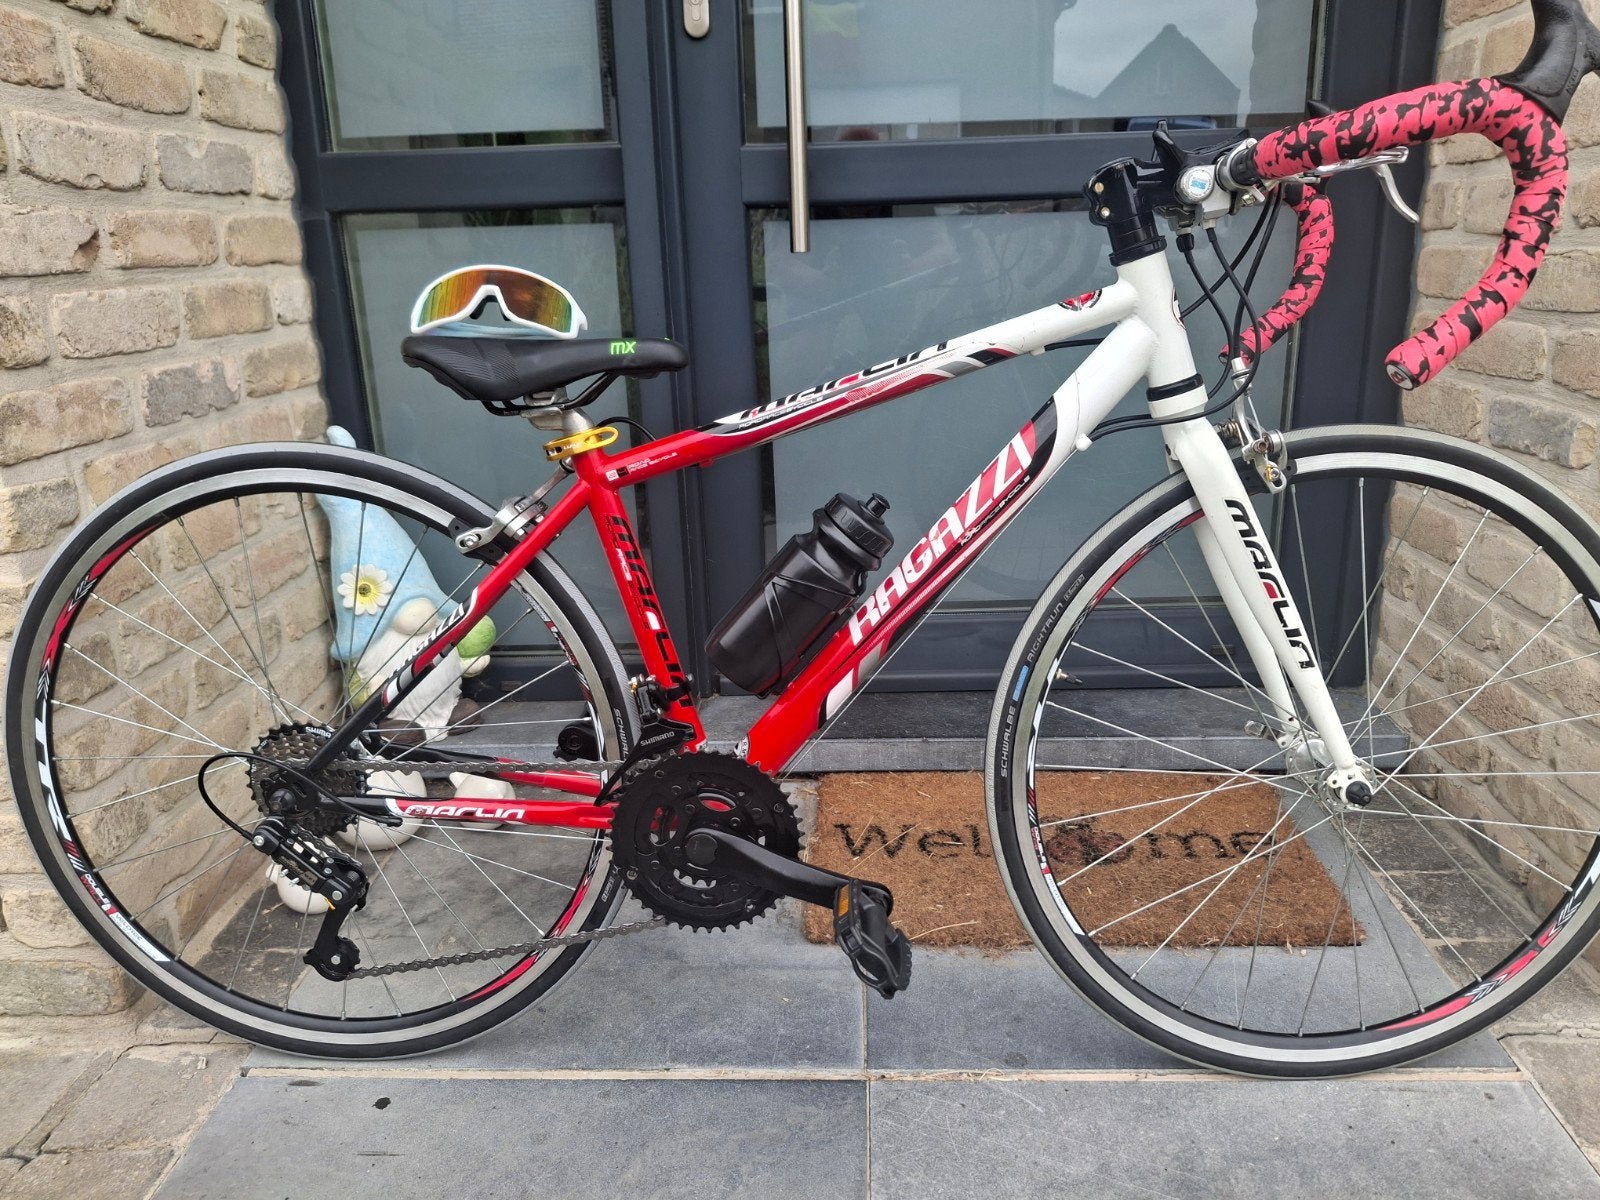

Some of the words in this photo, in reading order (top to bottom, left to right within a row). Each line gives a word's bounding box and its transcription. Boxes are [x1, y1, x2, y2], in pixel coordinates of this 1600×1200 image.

[848, 431, 1033, 646] RAGAZZI
[1000, 706, 1016, 779] SCHWALBE
[1026, 602, 1063, 663] RIGHTRUN
[305, 726, 332, 739] SHIMA
[613, 708, 629, 762] SCHWAL
[640, 731, 675, 747] SHIMANO
[84, 873, 111, 905] DOUBLE
